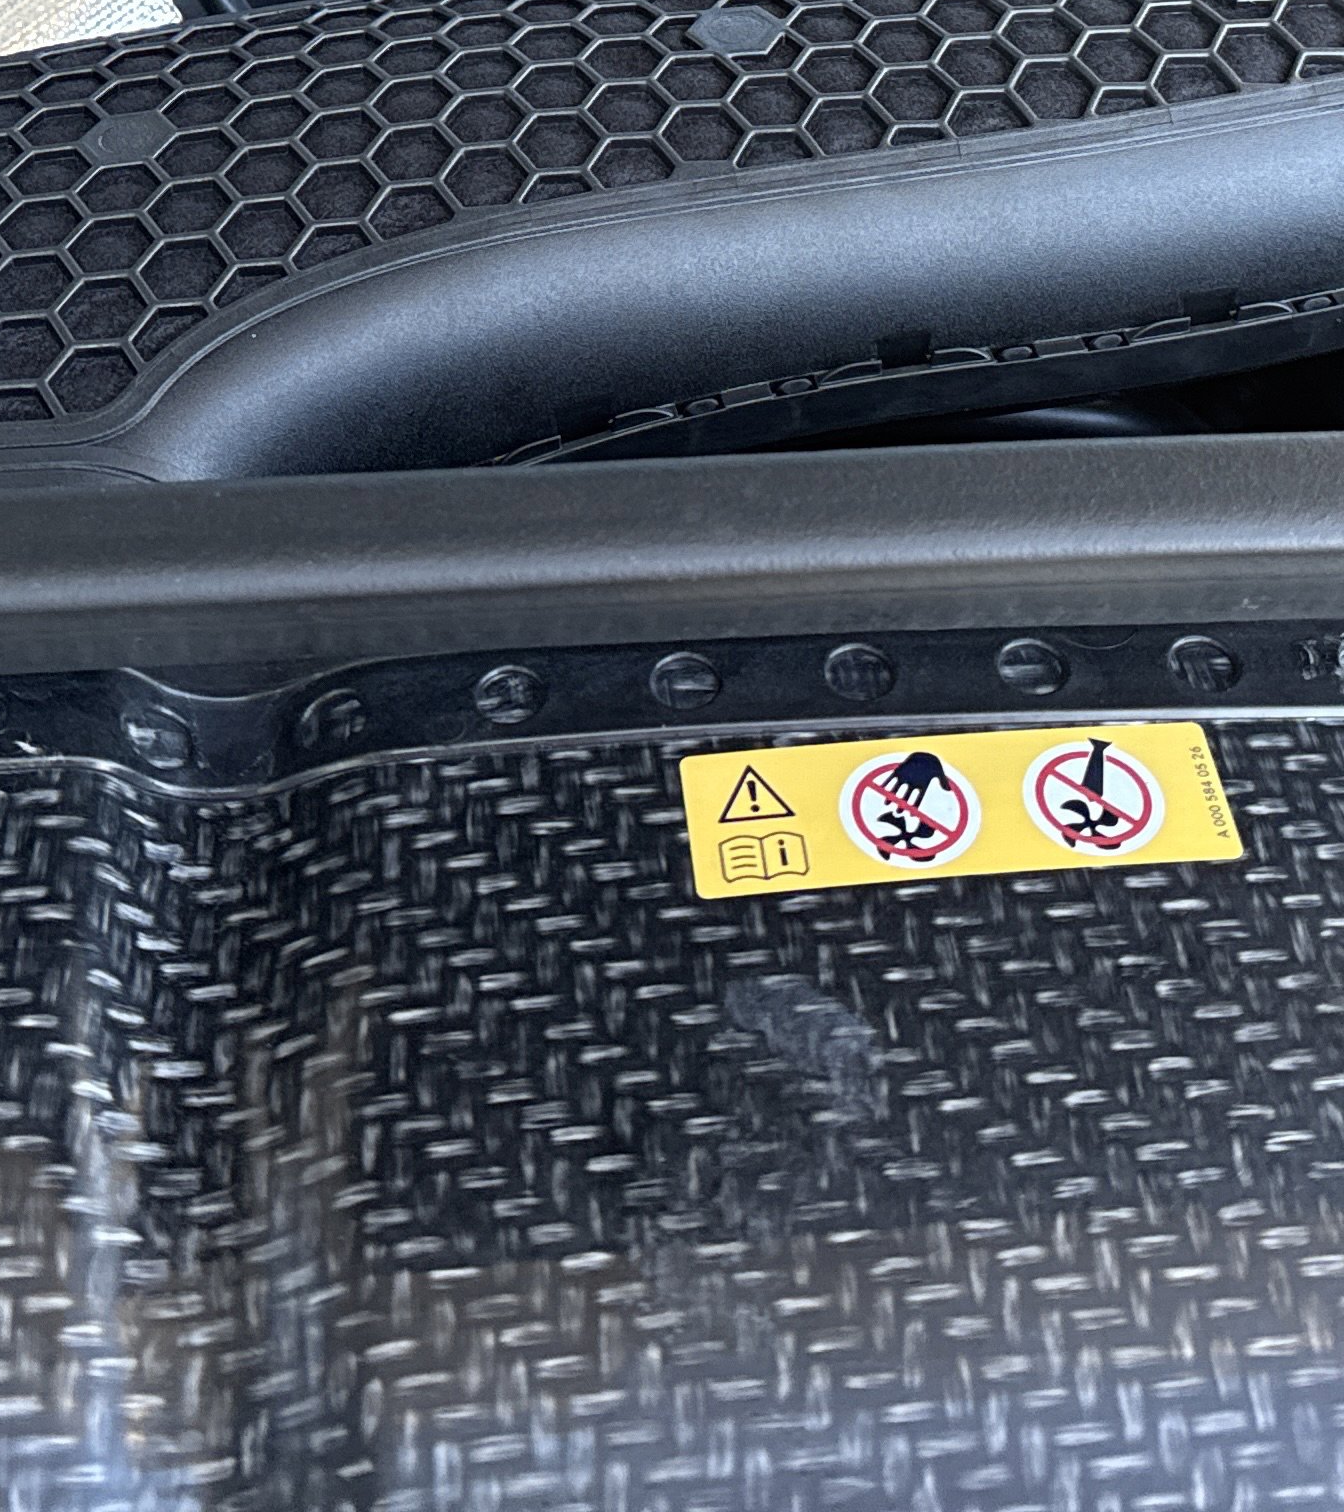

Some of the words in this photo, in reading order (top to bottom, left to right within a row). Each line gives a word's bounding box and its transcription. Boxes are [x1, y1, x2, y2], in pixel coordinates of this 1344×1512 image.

[1189, 745, 1205, 760] 26
[1194, 763, 1210, 778] 05
[1201, 780, 1219, 802] 584
[1208, 804, 1227, 828] 000
[1217, 829, 1231, 839] A
